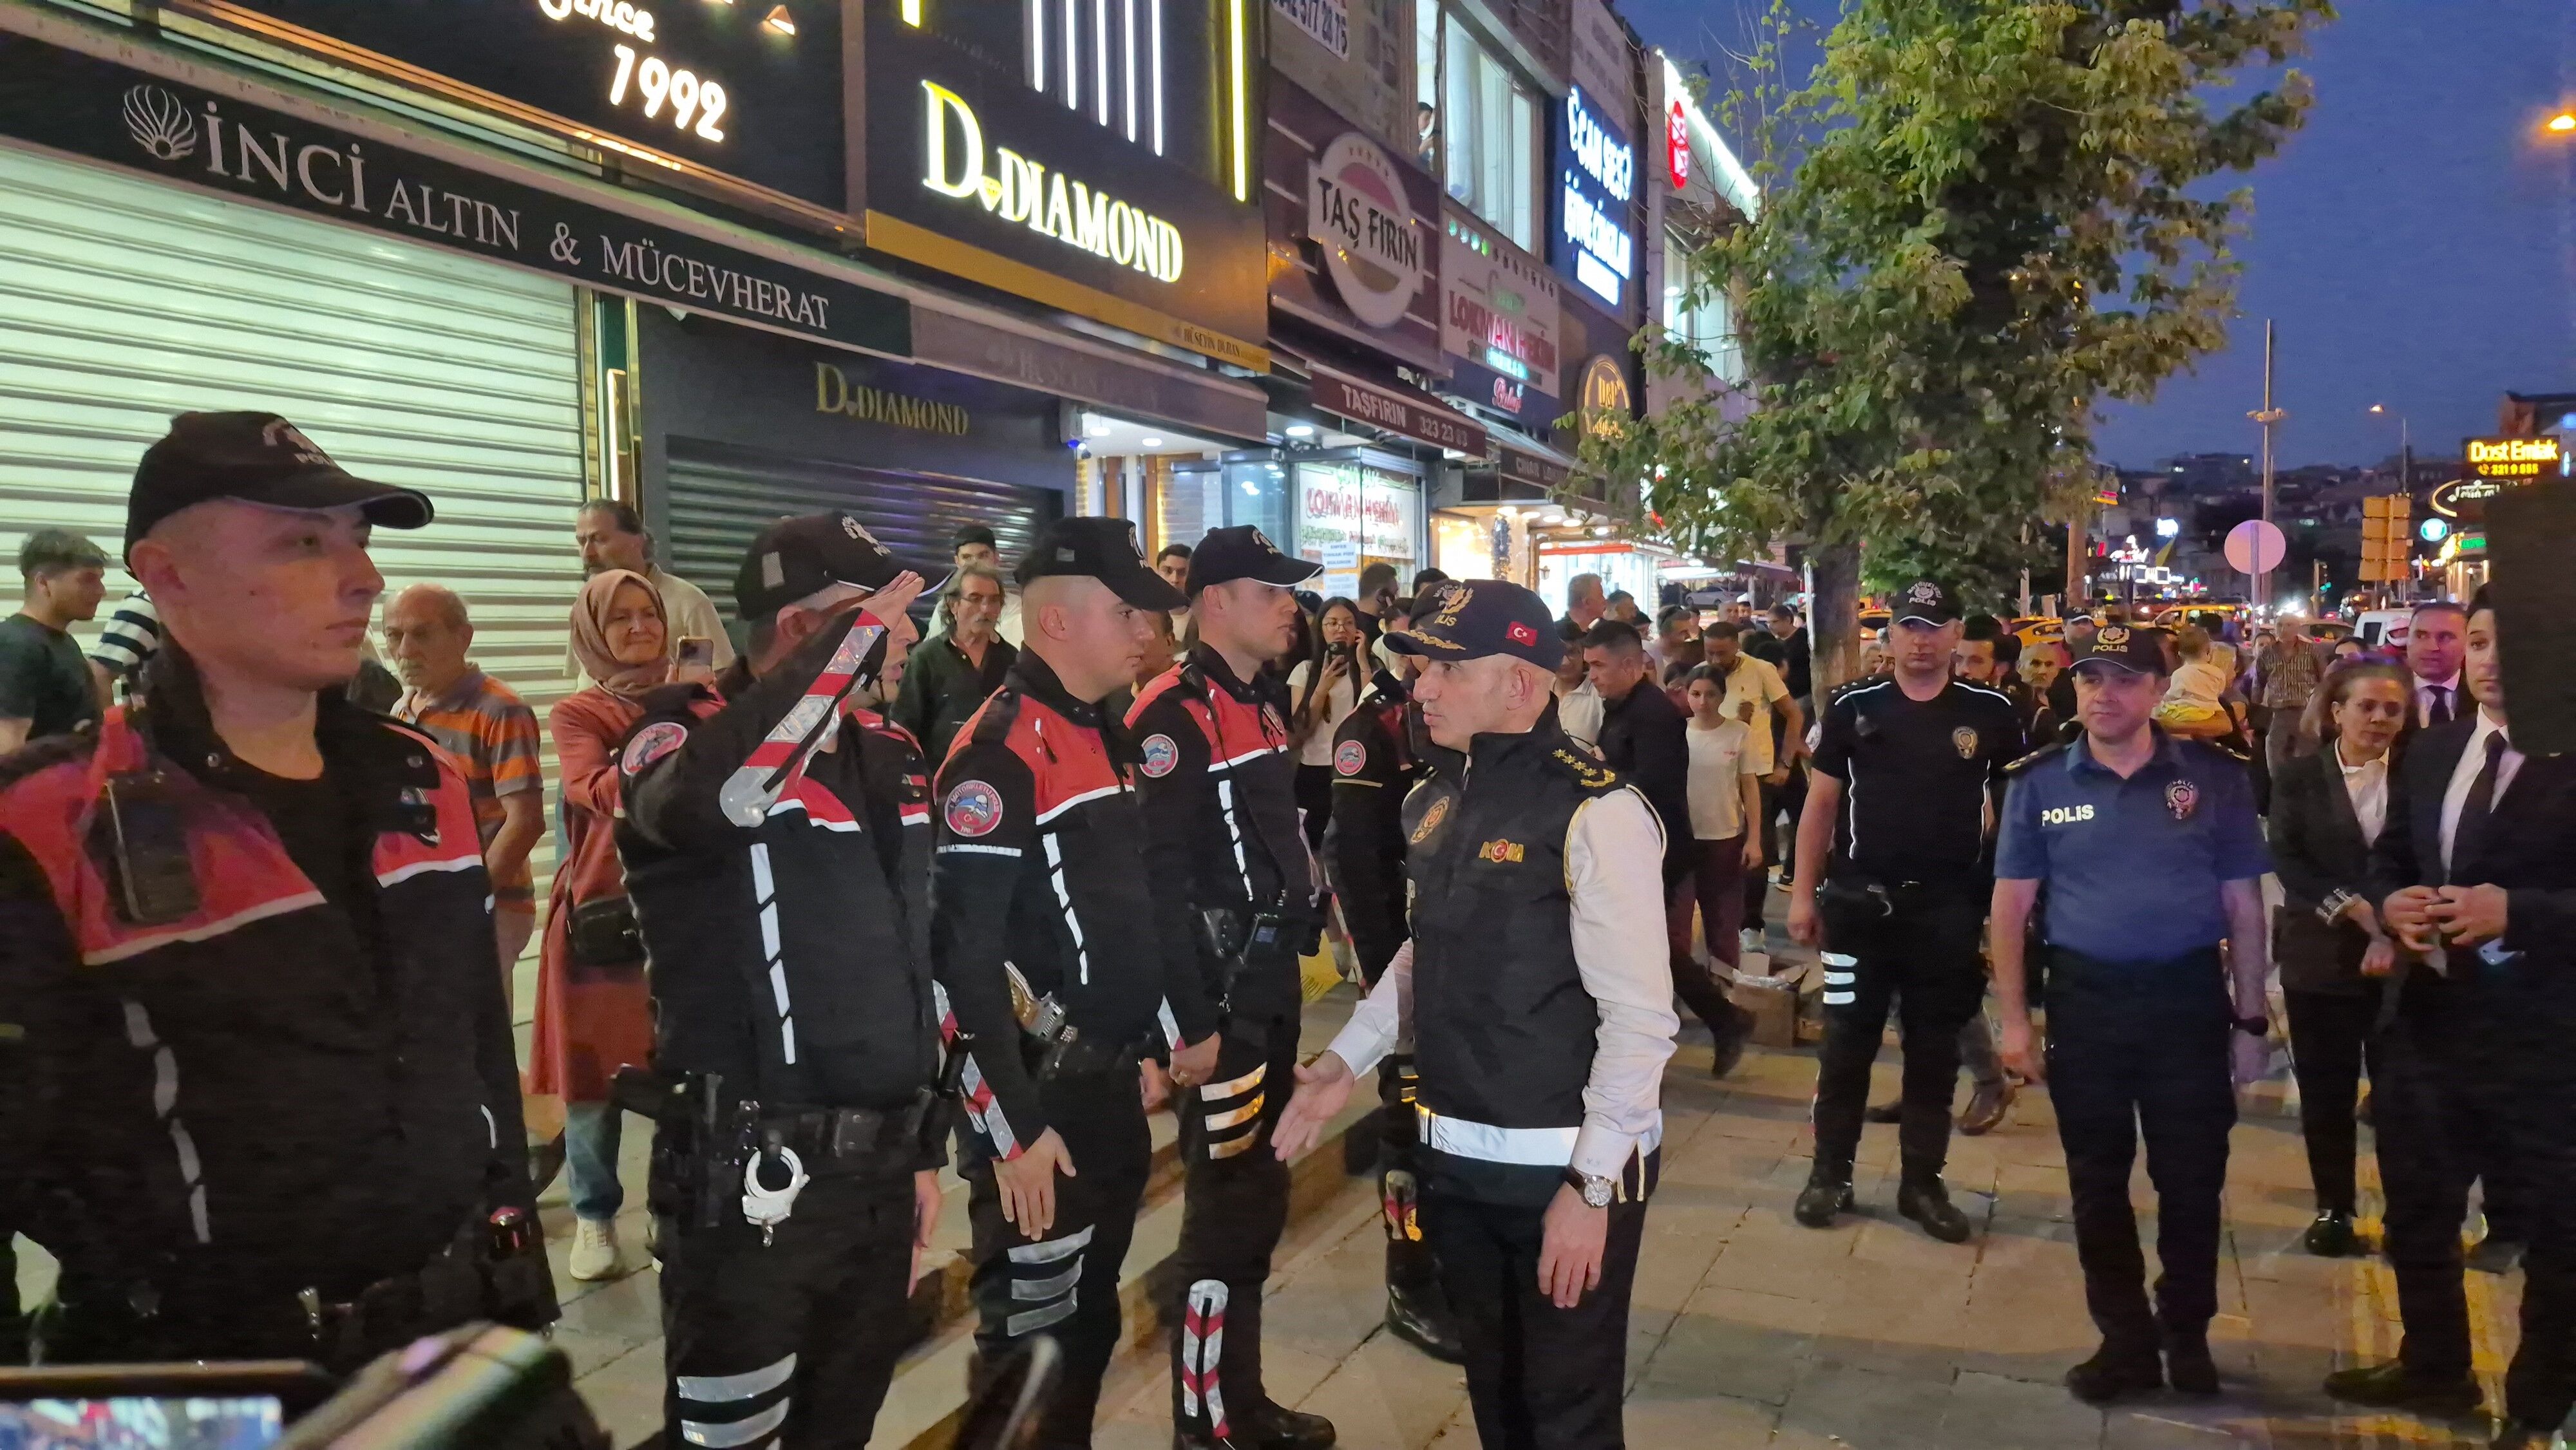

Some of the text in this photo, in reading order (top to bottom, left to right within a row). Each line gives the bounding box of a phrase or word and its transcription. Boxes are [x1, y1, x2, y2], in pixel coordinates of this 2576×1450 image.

[610, 43, 726, 143] 1992
[205, 100, 829, 330] İNCİ ALTIN & MÜCEVHERAT
[997, 146, 1184, 285] DIAMOND
[1318, 177, 1417, 274] TAŞ FIRIN
[857, 386, 970, 436] DIAMOND
[2470, 439, 2559, 462] Dost Emlak
